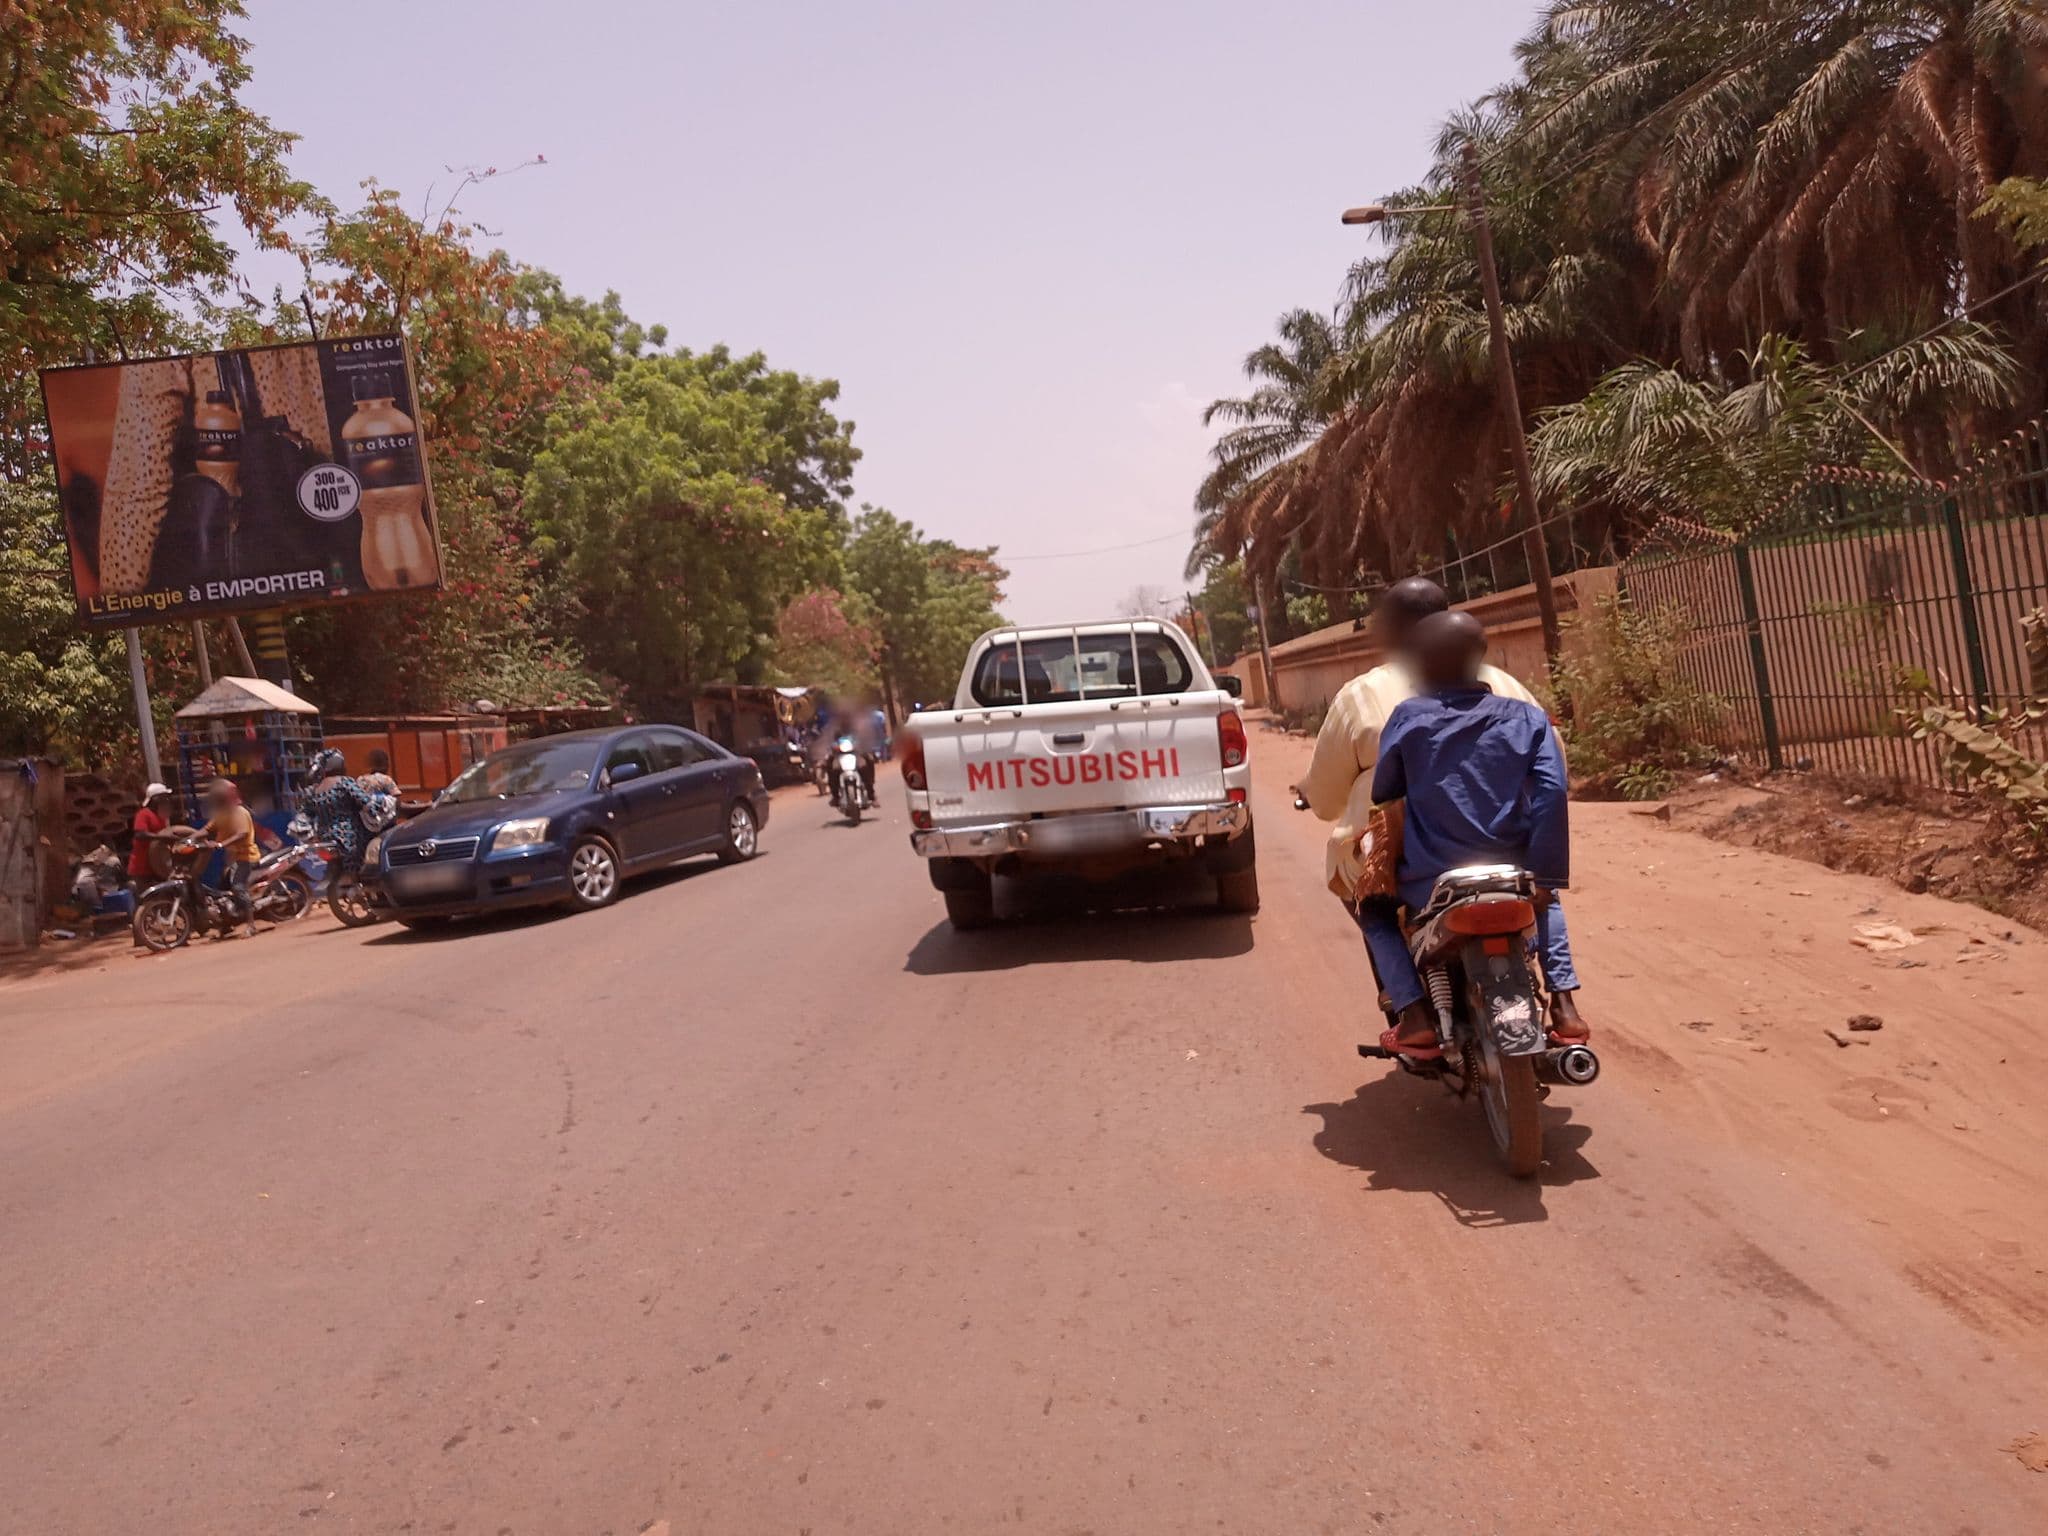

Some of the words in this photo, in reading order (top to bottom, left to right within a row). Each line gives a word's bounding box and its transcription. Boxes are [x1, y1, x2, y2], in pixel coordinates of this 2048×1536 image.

[333, 338, 402, 353] reaktor
[348, 437, 413, 453] reaktor
[314, 471, 335, 486] 300
[314, 487, 339, 511] 400
[189, 585, 201, 602] à
[206, 569, 326, 600] EMPORTER
[966, 747, 1180, 792] MITSUBISHI
